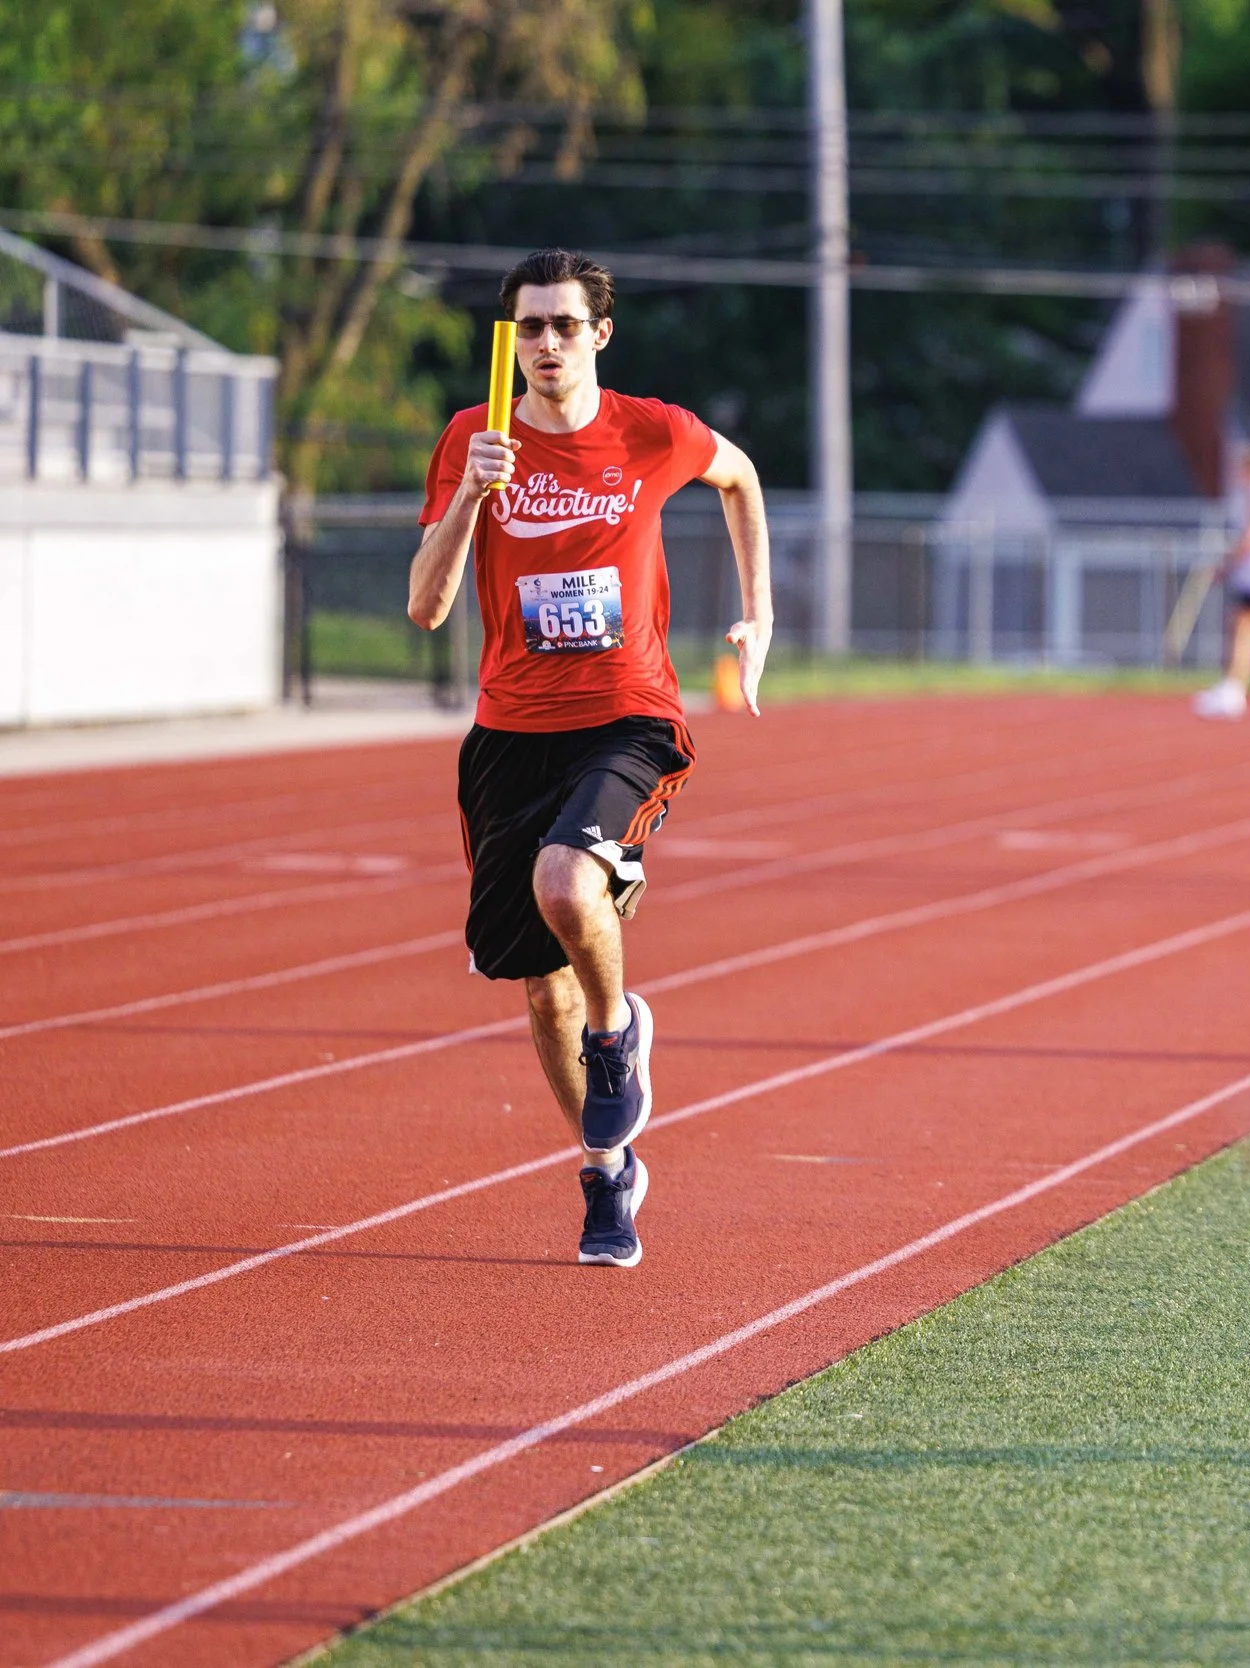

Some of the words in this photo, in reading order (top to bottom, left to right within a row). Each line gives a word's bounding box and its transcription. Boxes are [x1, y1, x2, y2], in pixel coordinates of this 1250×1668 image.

[528, 472, 560, 497] It's
[491, 479, 642, 526] Showtime!
[550, 589, 584, 599] WOMEN
[587, 586, 609, 596] 19-24
[562, 574, 596, 590] MILE
[538, 599, 606, 638] 653
